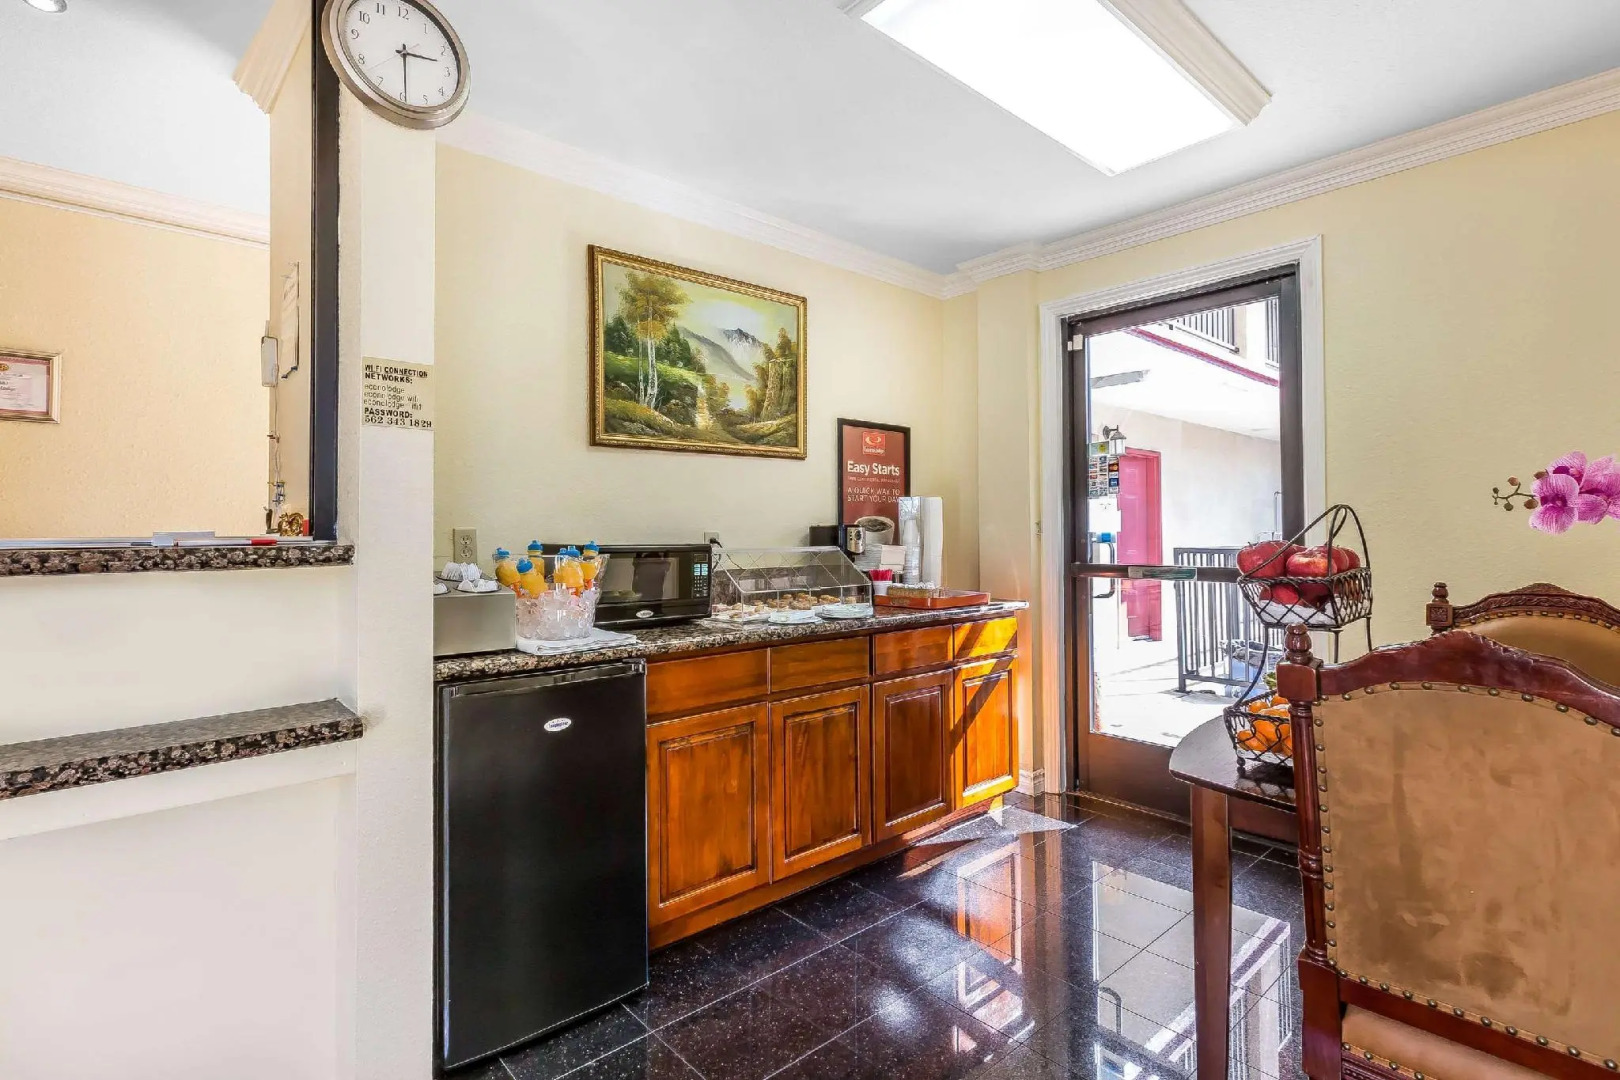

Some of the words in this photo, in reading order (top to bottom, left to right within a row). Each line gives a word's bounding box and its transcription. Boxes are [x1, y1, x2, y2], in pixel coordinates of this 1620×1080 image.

[376, 2, 385, 15] 11
[398, 6, 409, 20] 12
[359, 10, 370, 24] 10
[351, 28, 360, 39] 9
[424, 23, 428, 34] 1
[440, 45, 446, 56] 2
[358, 54, 365, 64] 8
[444, 66, 451, 78] 3
[376, 76, 384, 86] 7
[438, 86, 444, 96] 4
[423, 94, 428, 105] 5
[384, 366, 428, 377] CONNECTION
[365, 373, 413, 384] NETWORKS:
[364, 407, 412, 418] PASSWORD:
[365, 415, 384, 424] 562
[387, 417, 405, 425] 343
[847, 460, 870, 476] Easy
[872, 462, 900, 476] Starts
